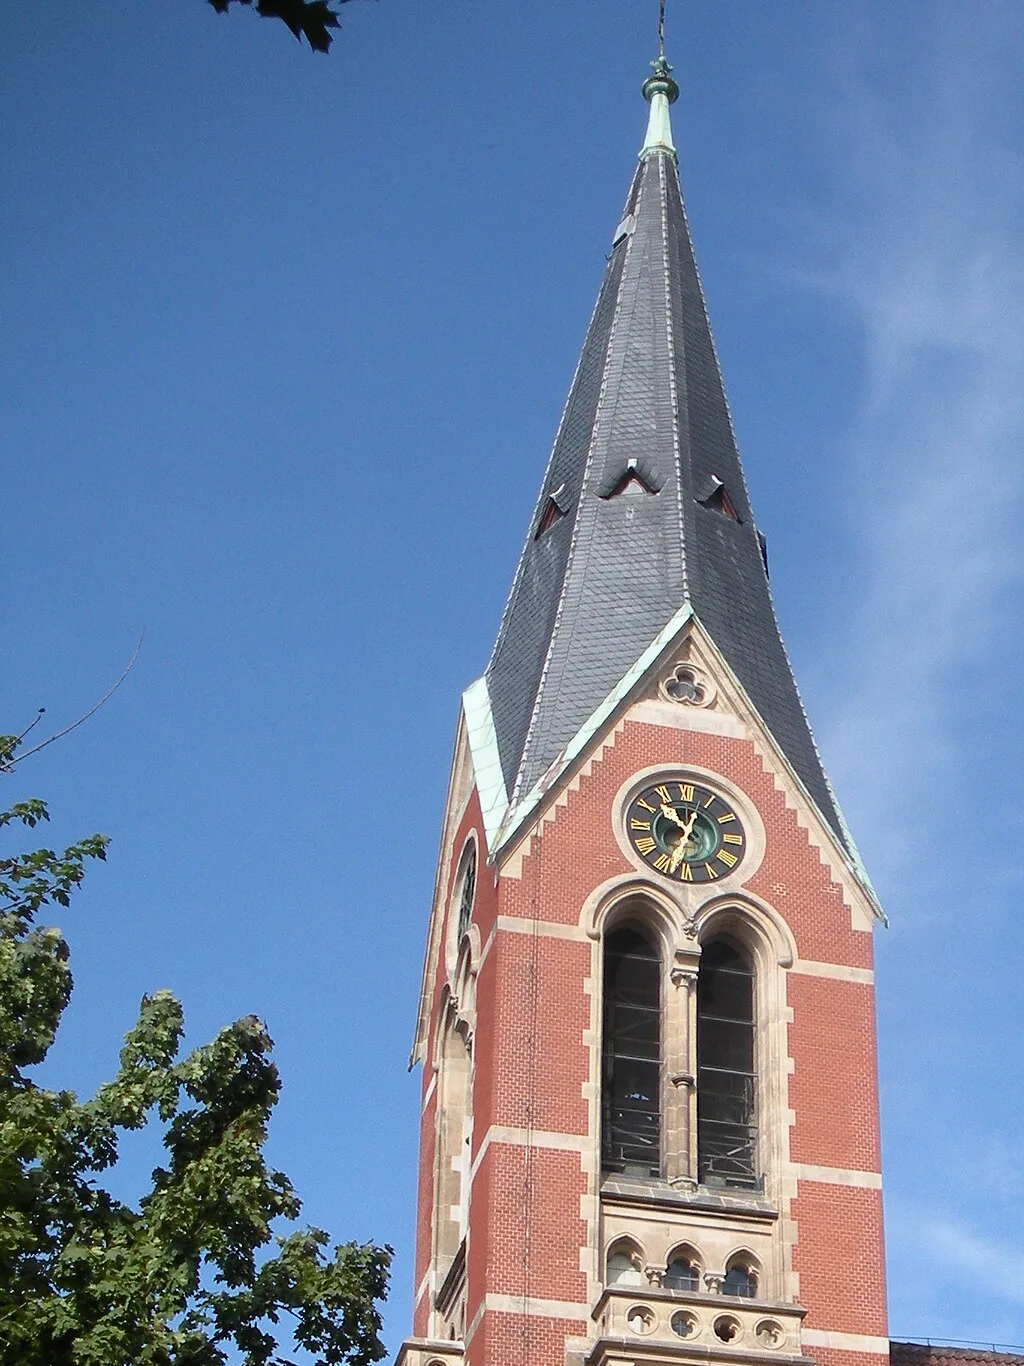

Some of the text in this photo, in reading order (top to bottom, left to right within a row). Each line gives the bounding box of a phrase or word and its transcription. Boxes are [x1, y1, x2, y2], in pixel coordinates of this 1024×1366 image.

[655, 785, 672, 804] XI
[679, 784, 694, 801] XII
[637, 799, 656, 813] X
[704, 795, 715, 808] I
[631, 818, 650, 830] IX
[717, 813, 736, 824] II
[723, 834, 742, 845] III
[681, 863, 693, 881] VI
[705, 863, 718, 879] V
